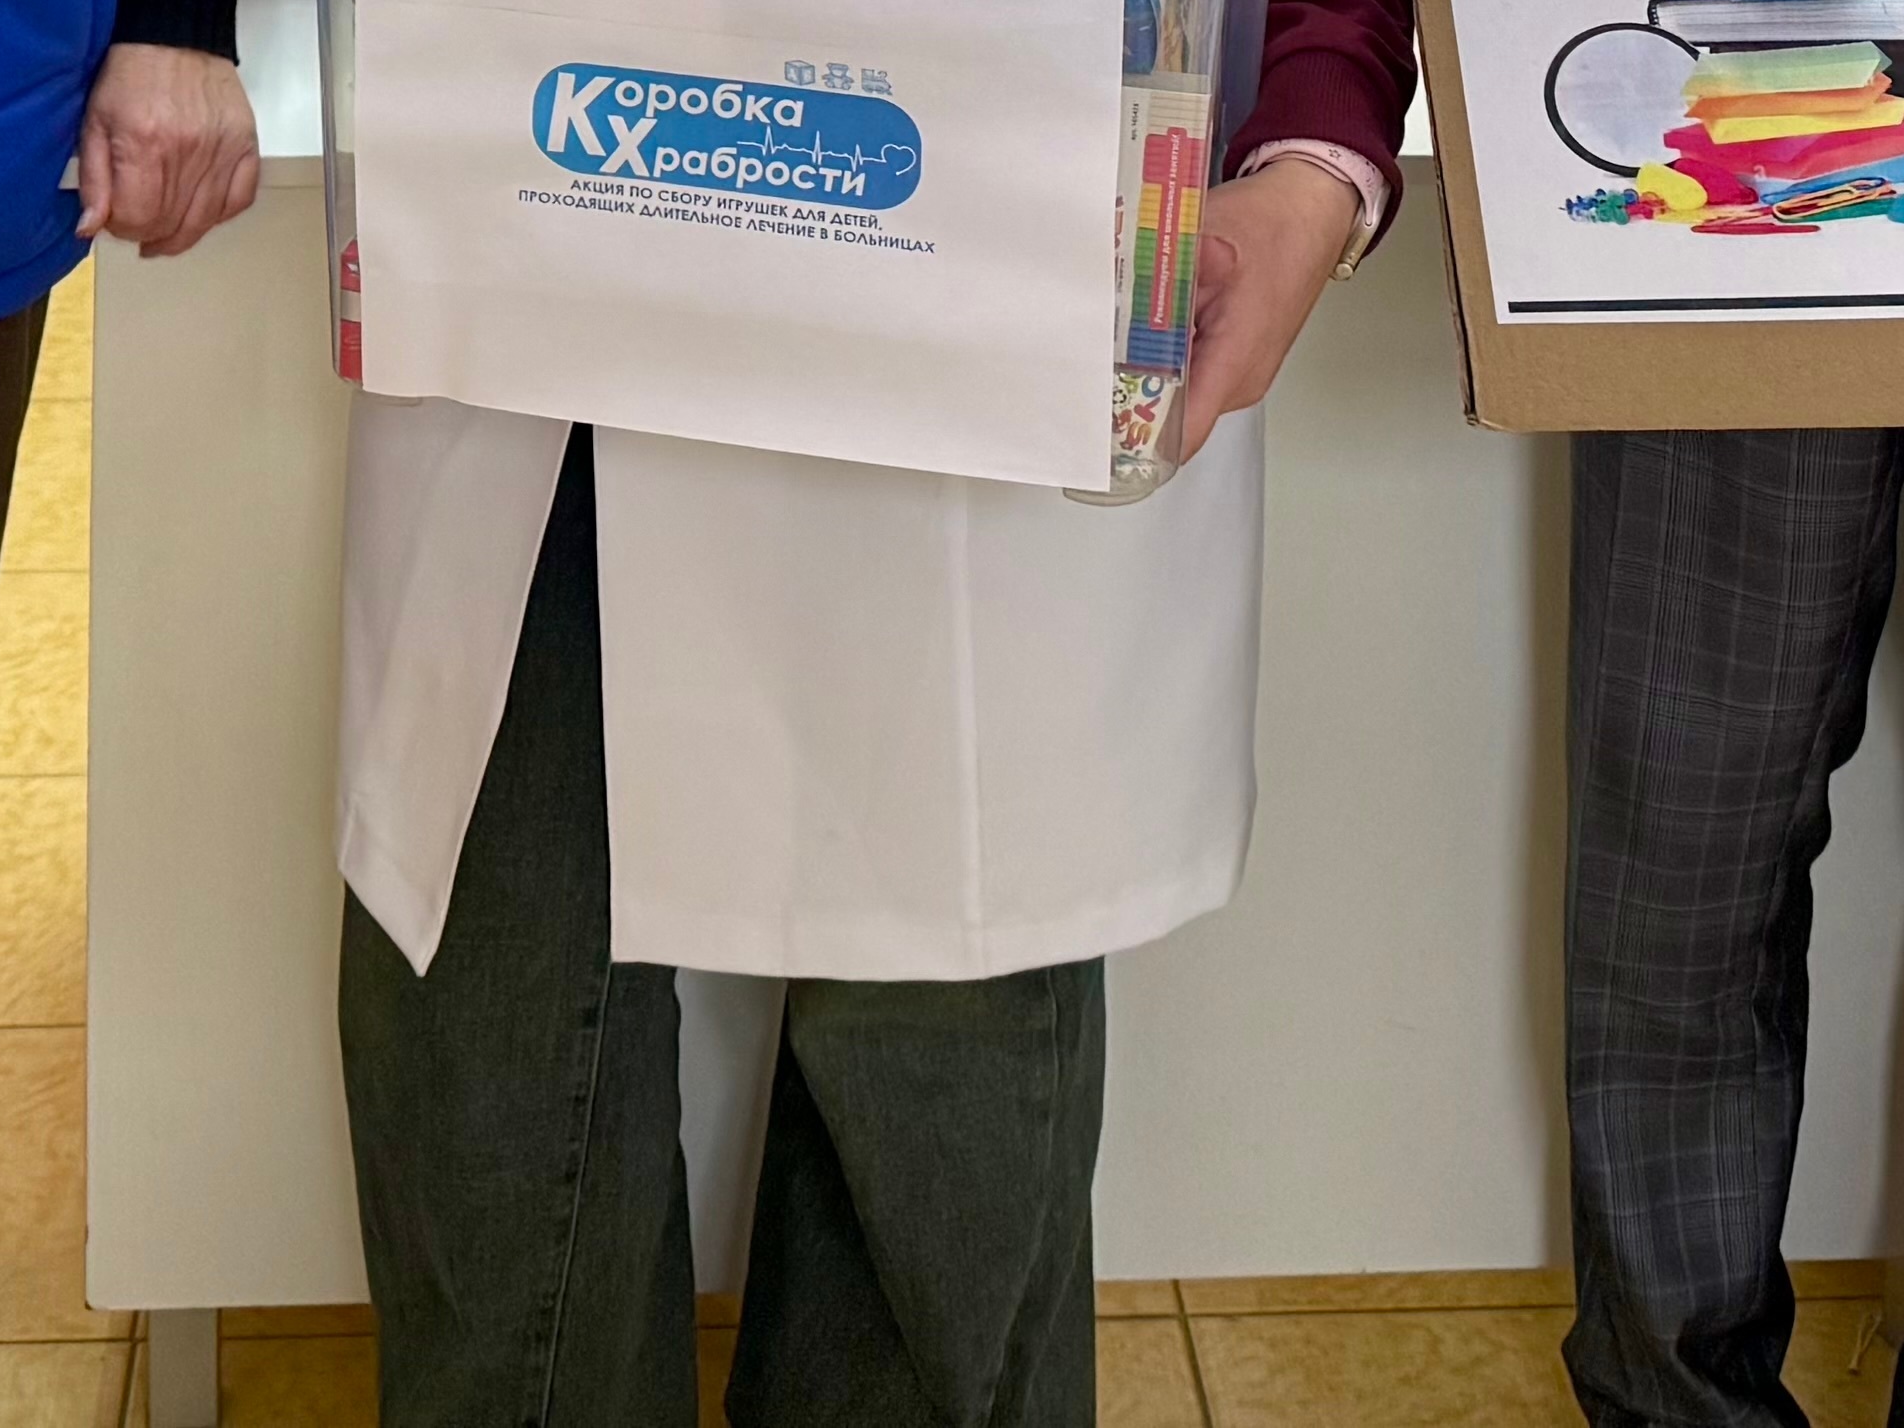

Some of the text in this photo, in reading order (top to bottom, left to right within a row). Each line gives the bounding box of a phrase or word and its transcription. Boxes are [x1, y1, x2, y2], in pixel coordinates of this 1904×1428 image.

[546, 71, 805, 157] Коробка
[599, 114, 867, 198] Храбрости
[518, 189, 936, 254] ПРОХОДЯЩИХ ДЛИТЕЛЬНОЕ ЛЕЧЕНИЕ В БОЛЬНИЦАХ
[570, 179, 625, 197] АКЦИЯ
[629, 185, 653, 199] ПО
[658, 189, 713, 207] СБОРУ
[716, 197, 788, 218] ИГРУШЕК
[792, 208, 826, 222] ДЛЯ
